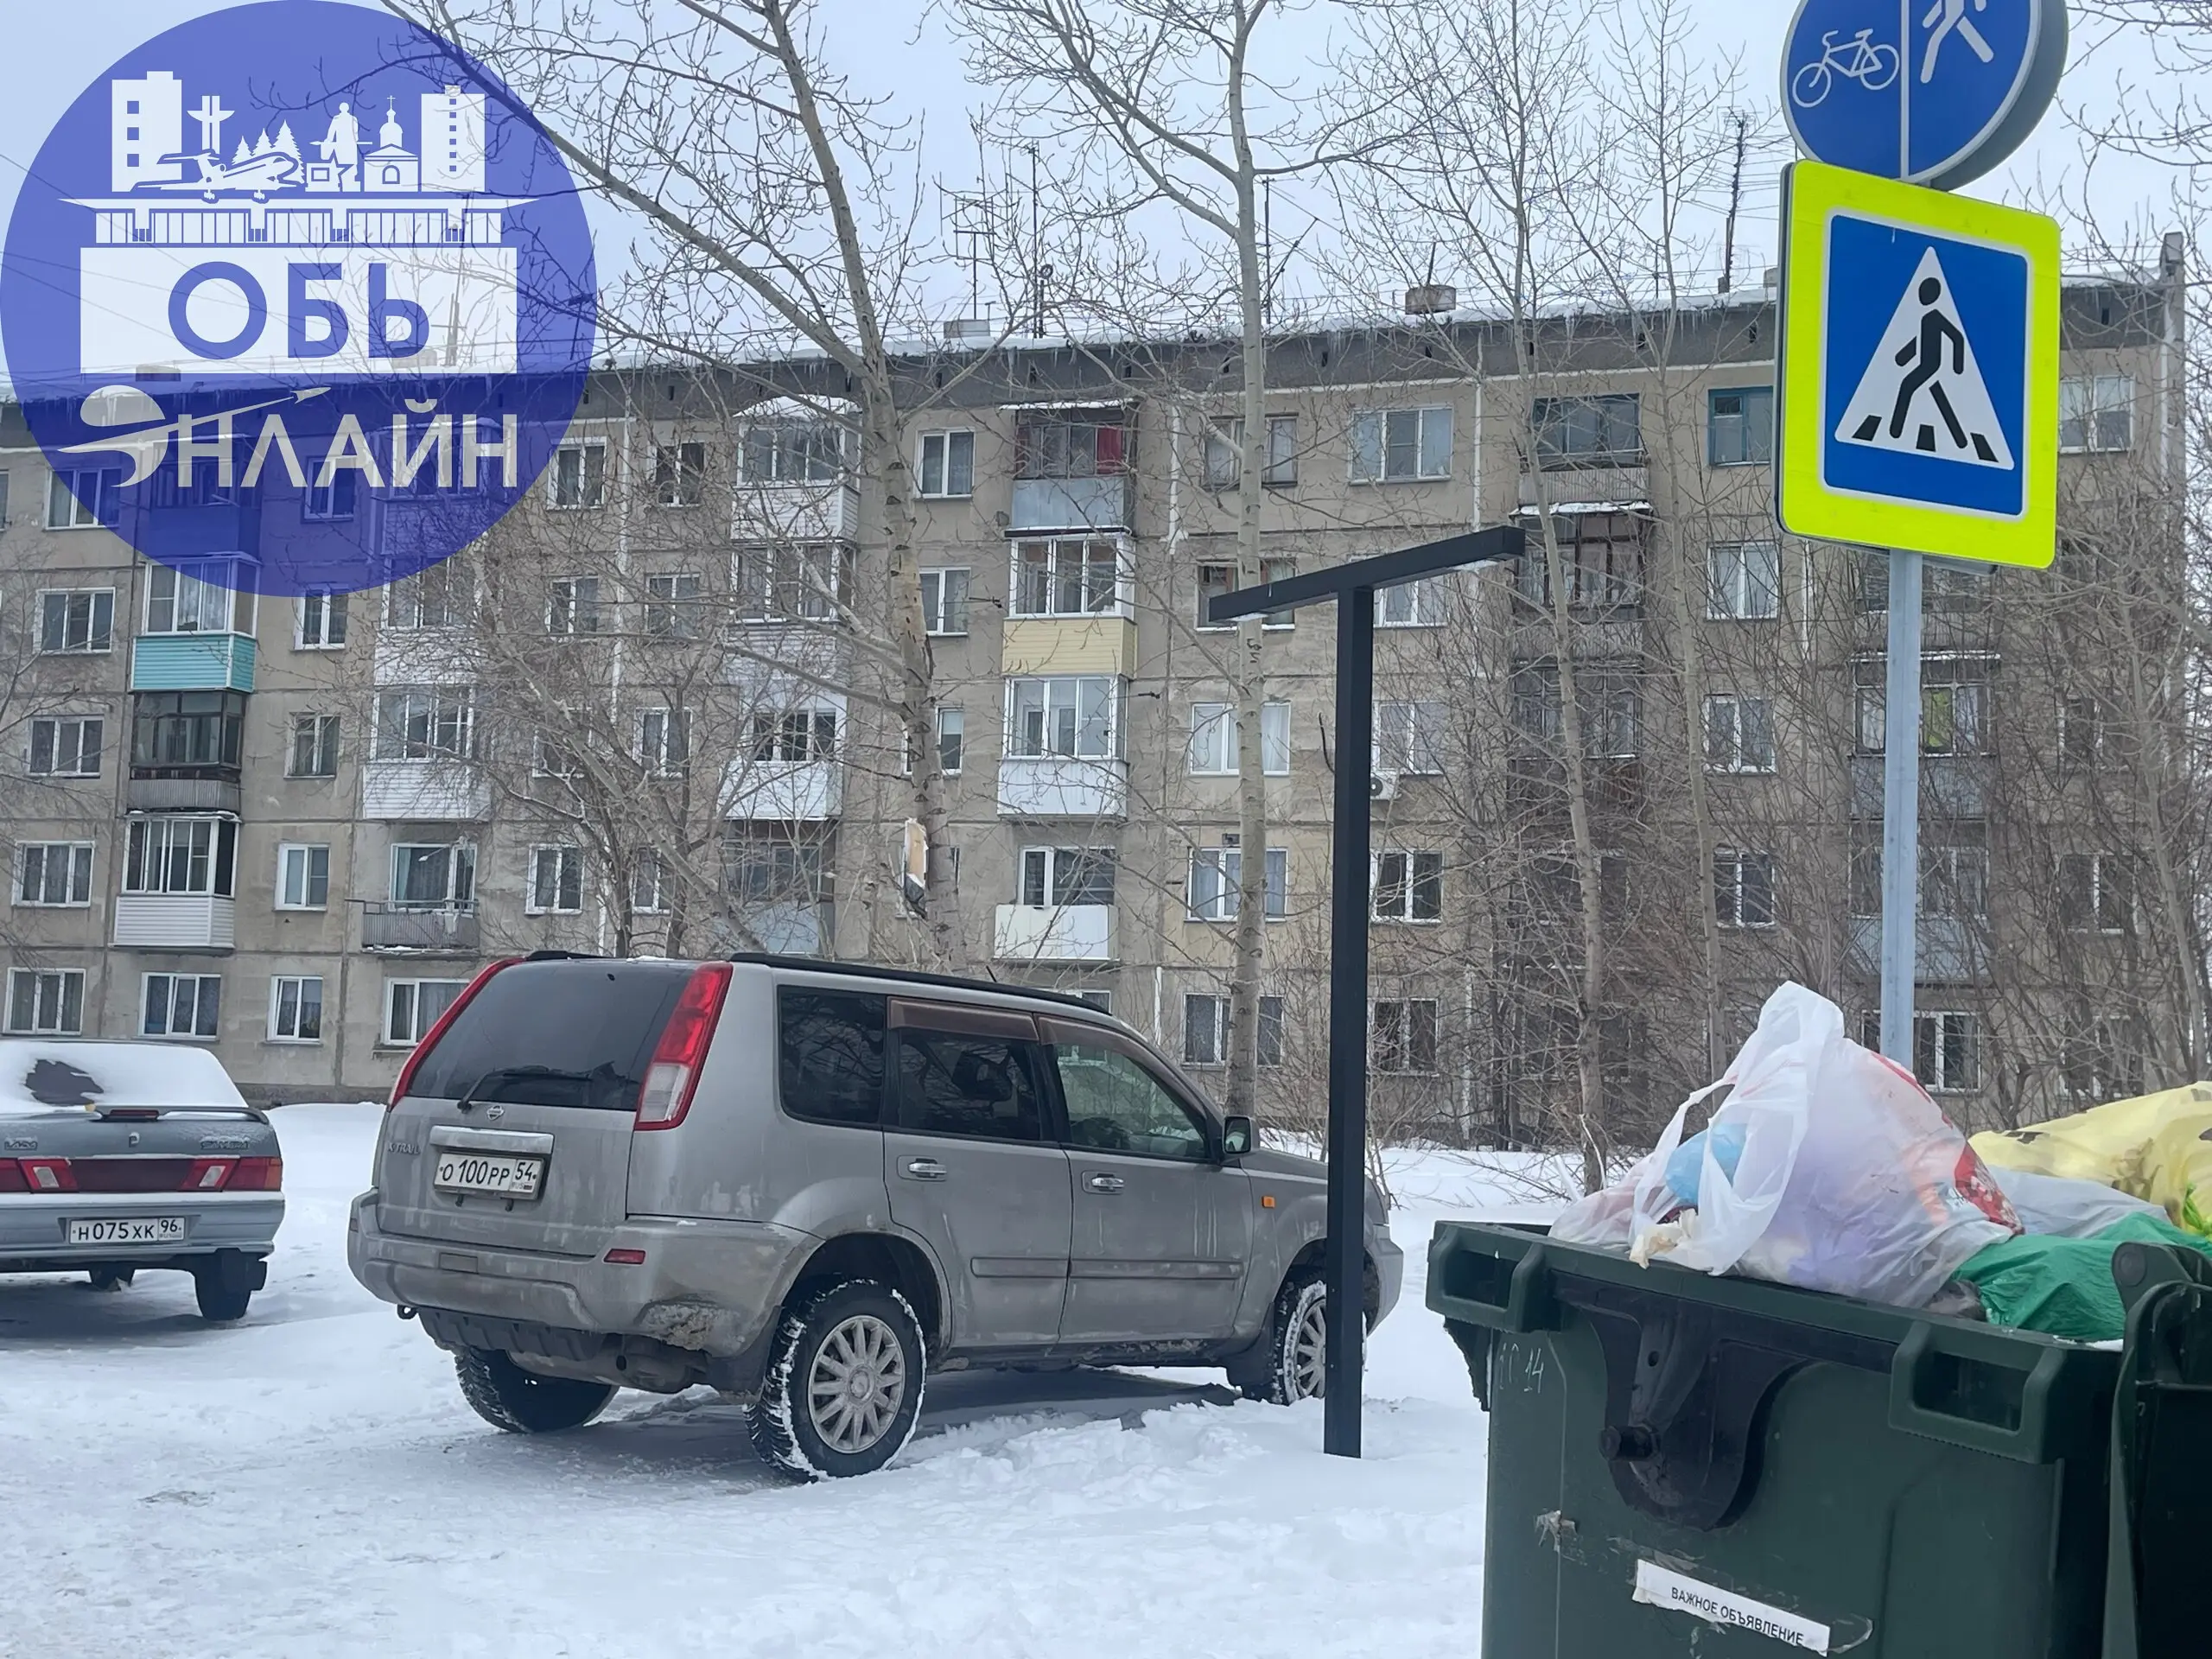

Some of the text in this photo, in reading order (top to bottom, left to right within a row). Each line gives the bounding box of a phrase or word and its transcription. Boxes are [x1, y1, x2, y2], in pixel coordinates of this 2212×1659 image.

[515, 1161, 534, 1181] 54
[160, 1219, 178, 1233] 96
[1671, 1586, 1804, 1644] ВАЖНОЕ ОБЪЯВЛЕНИЕ
